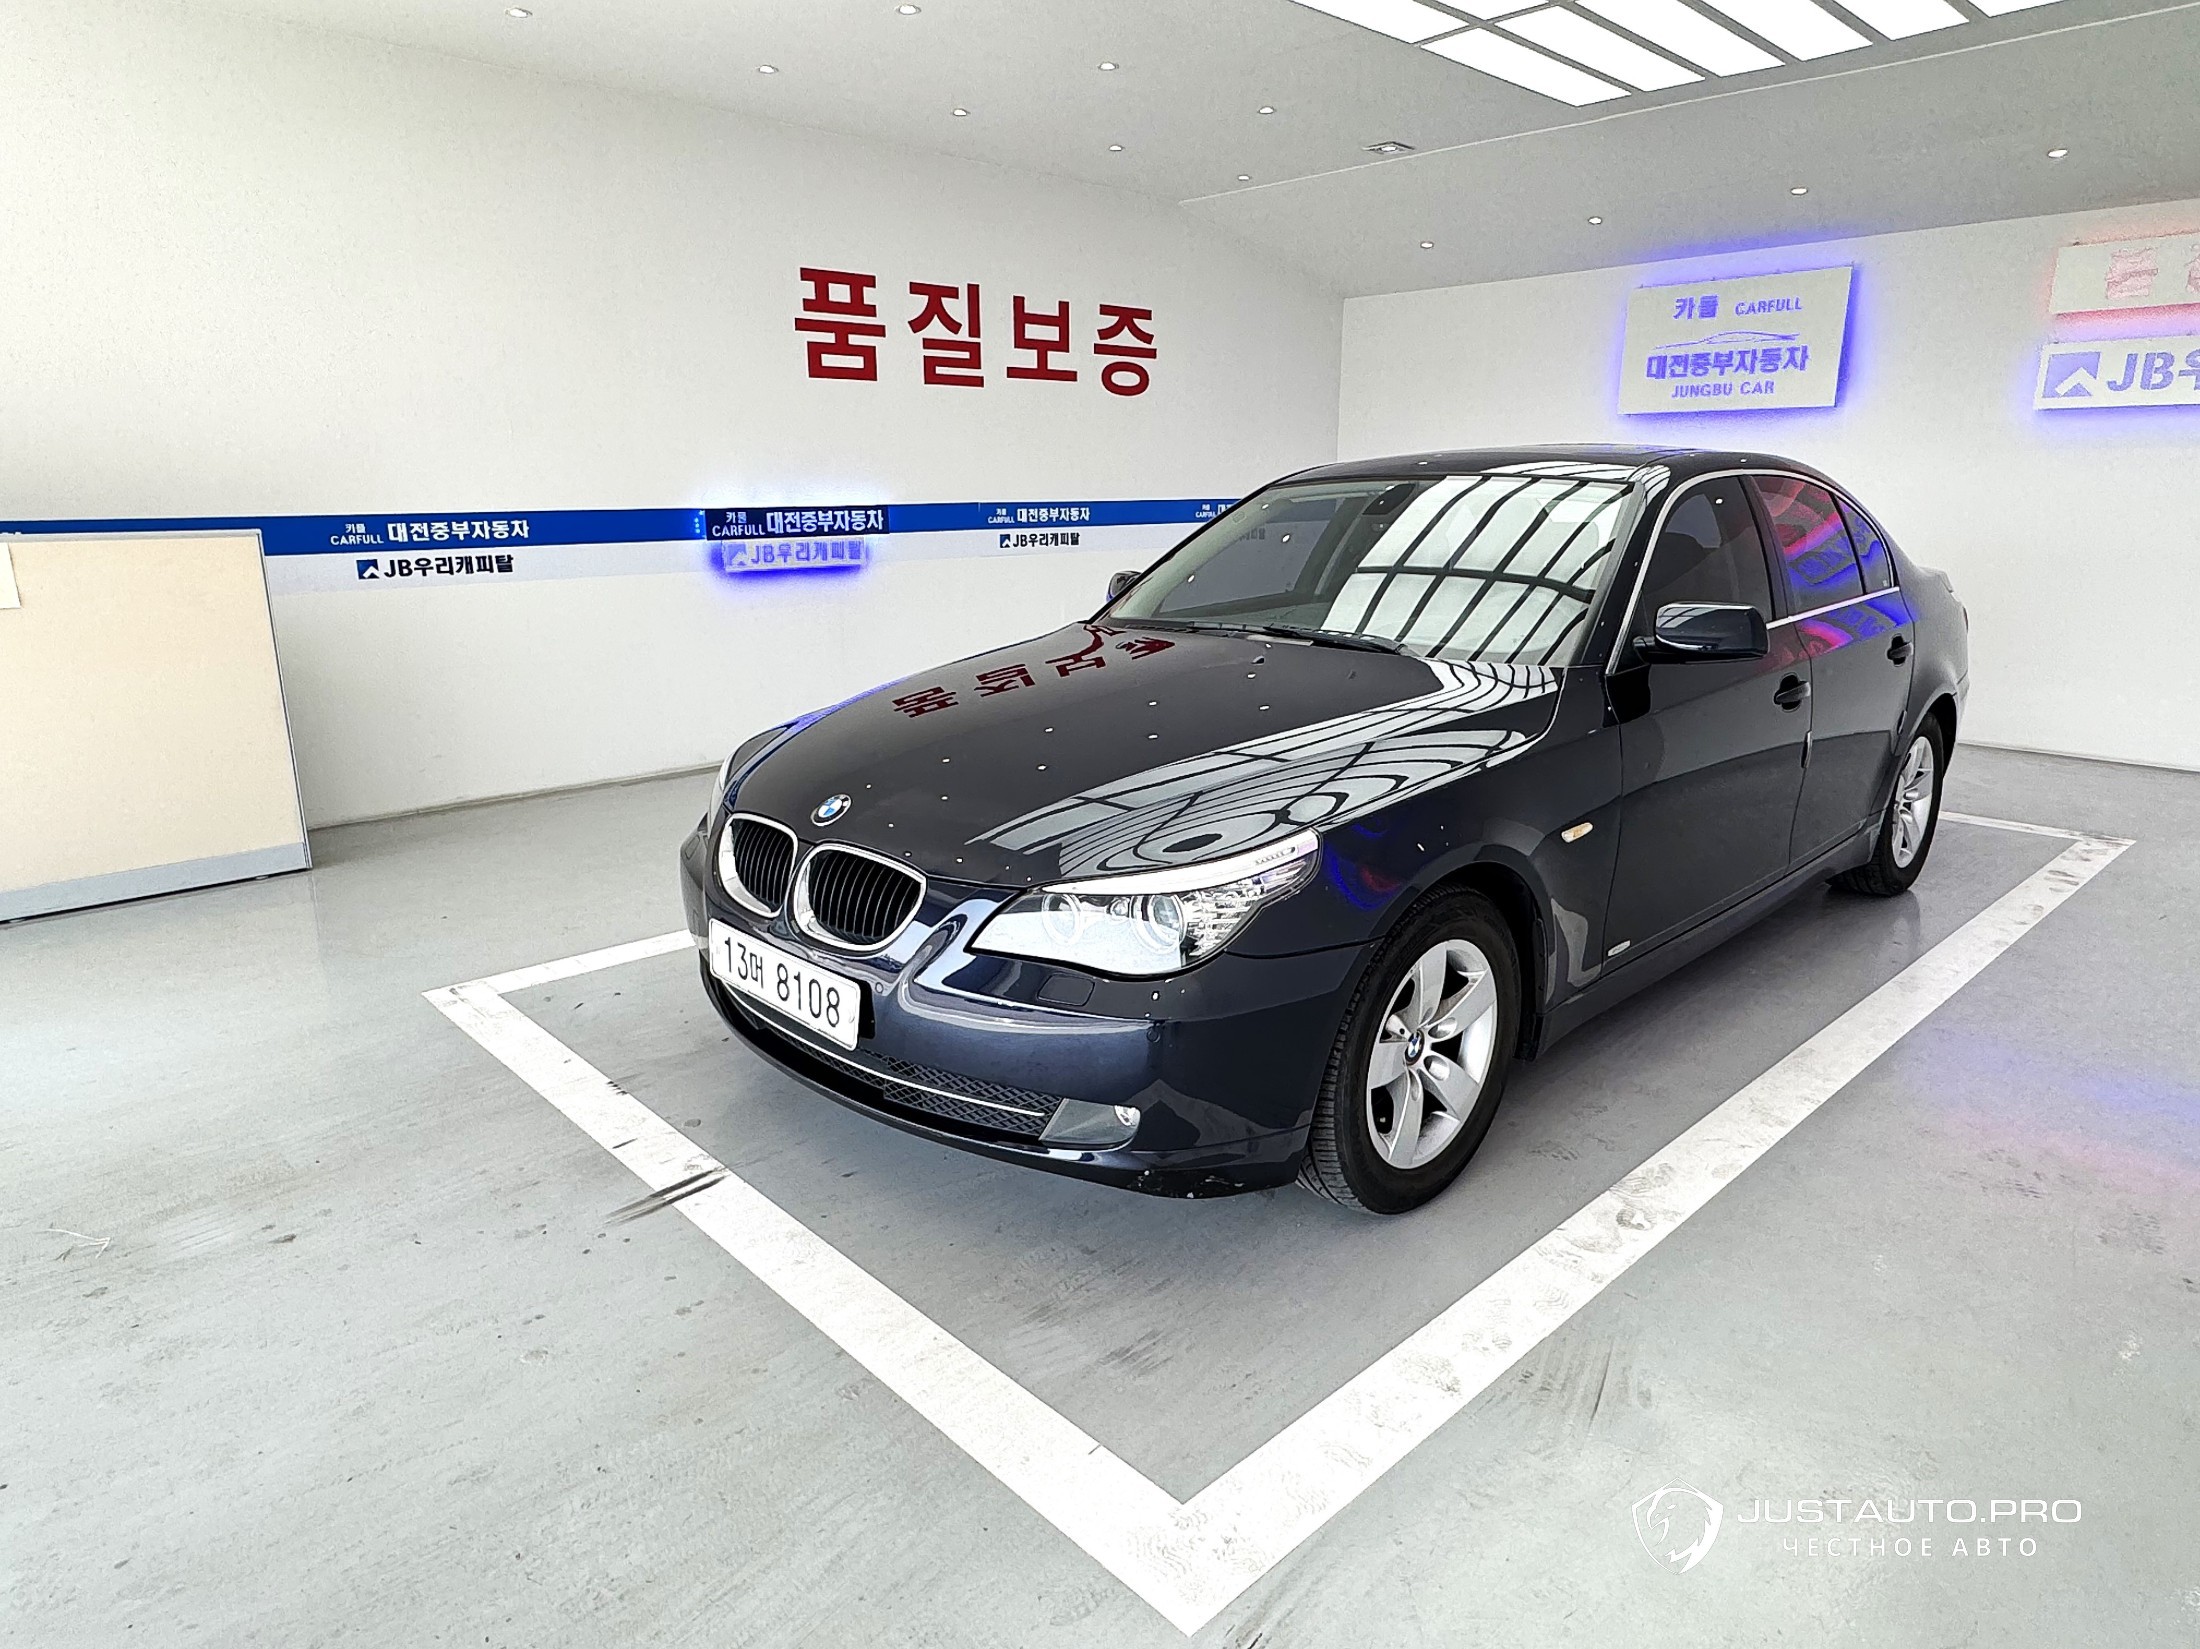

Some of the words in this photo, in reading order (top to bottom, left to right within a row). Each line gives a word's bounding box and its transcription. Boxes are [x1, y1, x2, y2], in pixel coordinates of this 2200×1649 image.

[1735, 296, 1803, 317] CARFULL
[794, 266, 1157, 397] 품질보증
[1645, 345, 1811, 380] 대전중부자동차
[1671, 383, 1733, 399] JUNGBU
[1740, 380, 1775, 395] CAR
[766, 509, 884, 535] 대전중부자동차
[1016, 507, 1090, 523] 대전중부자동차
[330, 534, 385, 546] CARFULL
[387, 520, 530, 543] 대전중부자동차
[712, 523, 766, 537] CARFULL
[383, 554, 514, 578] JB우리캐피탈
[724, 936, 764, 989] 13머
[776, 963, 840, 1028] 8108
